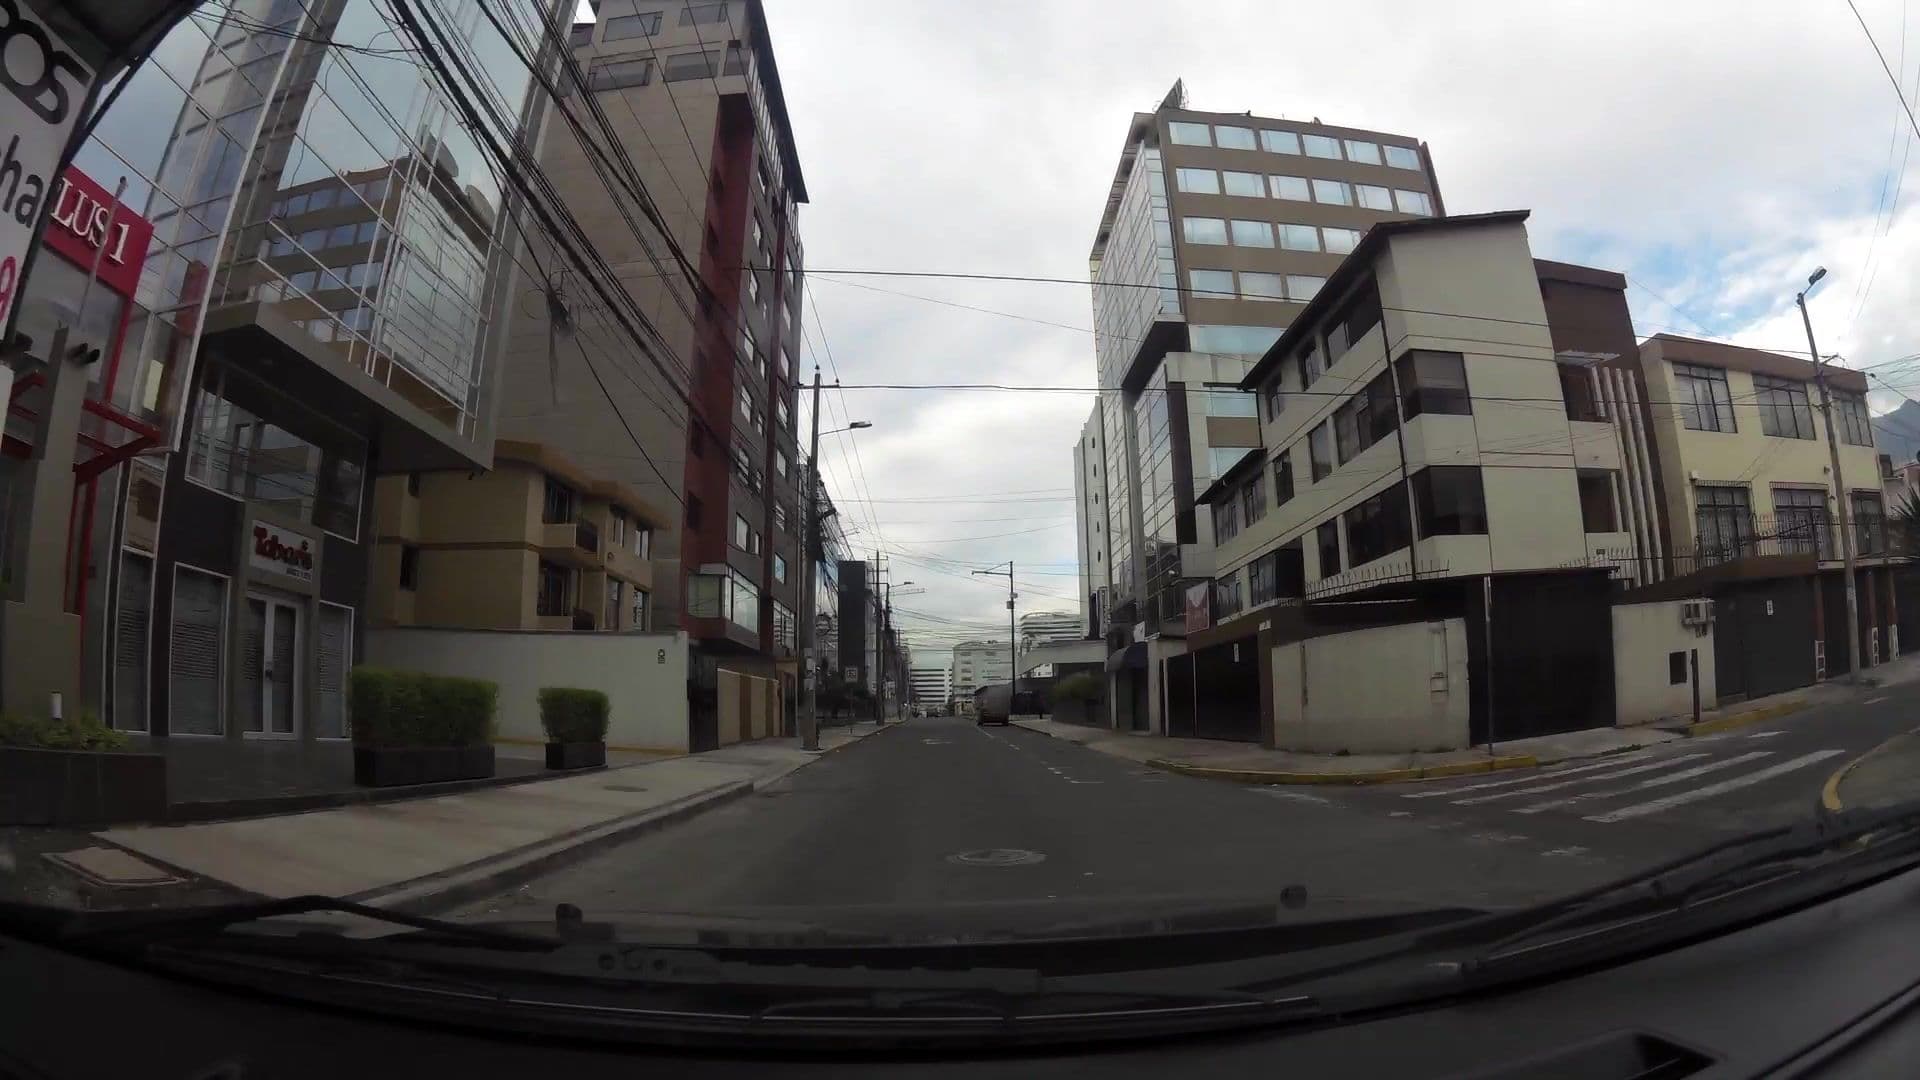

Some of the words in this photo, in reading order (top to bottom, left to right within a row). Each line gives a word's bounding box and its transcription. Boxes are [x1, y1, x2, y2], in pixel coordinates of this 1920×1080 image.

[0, 134, 44, 229] ha
[50, 176, 109, 248] LUS
[109, 222, 130, 265] 1
